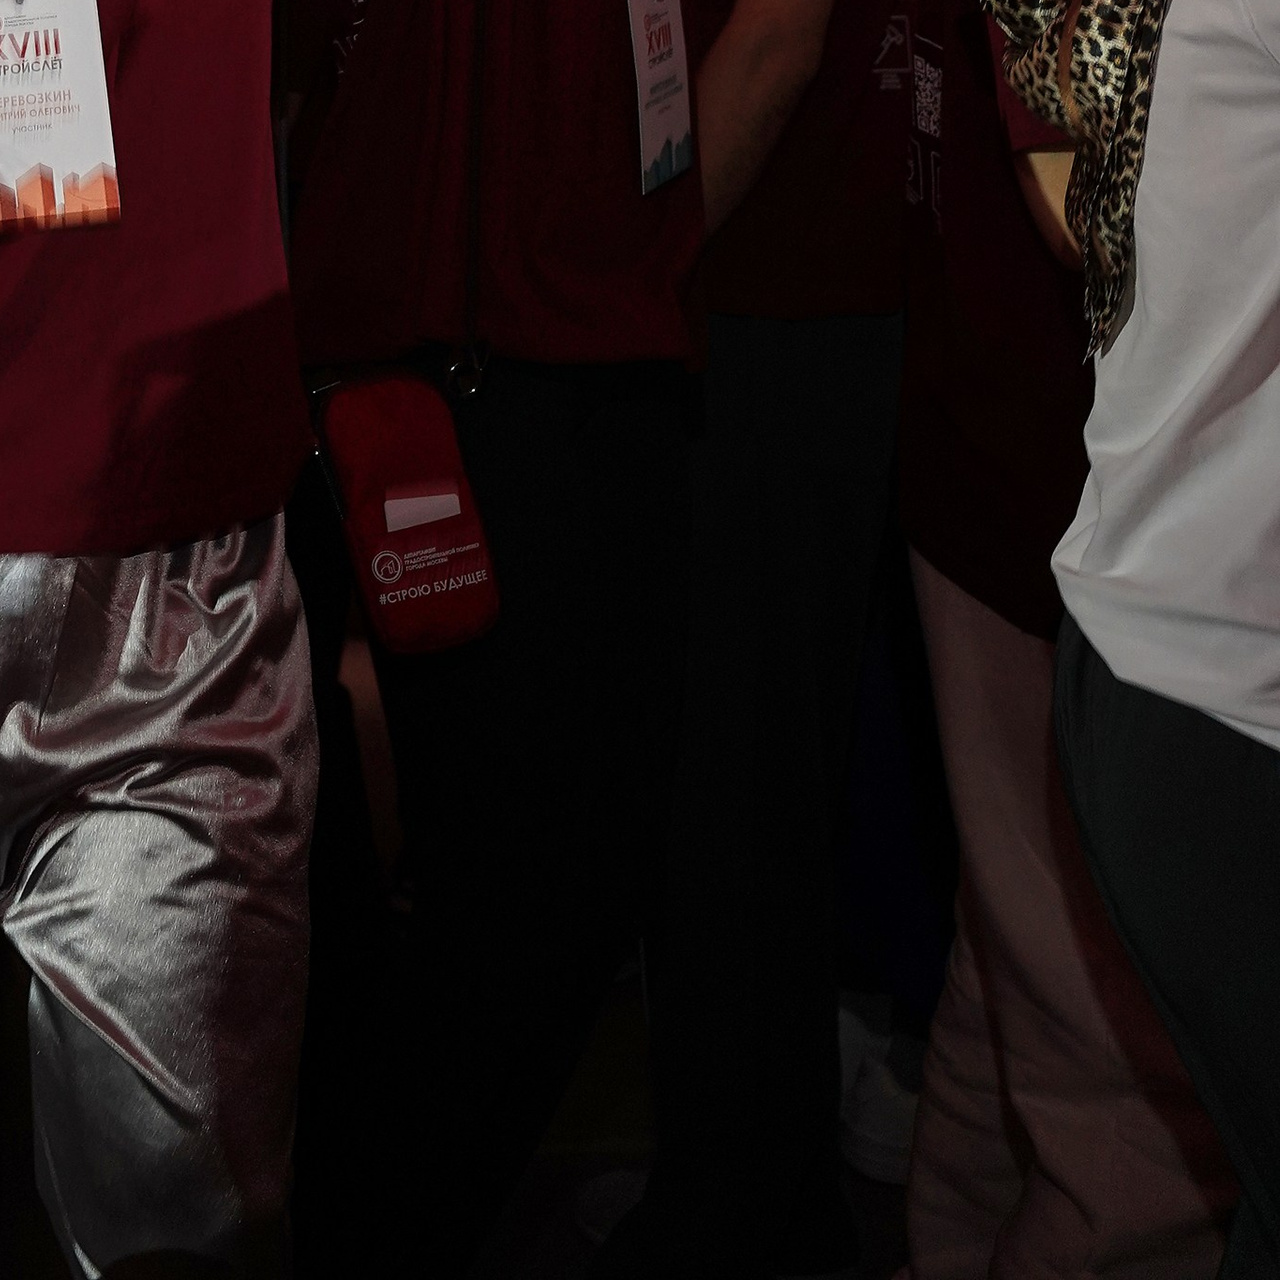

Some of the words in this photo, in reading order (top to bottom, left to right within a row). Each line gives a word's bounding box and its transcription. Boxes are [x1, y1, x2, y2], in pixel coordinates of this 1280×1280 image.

[645, 20, 673, 57] XVIII
[28, 104, 82, 118] ОЛЕГОВИЧ
[405, 562, 426, 572] ГОРОДА
[379, 584, 431, 605] #СТРОЮ
[433, 569, 488, 592] БУДУЩЕЕ
